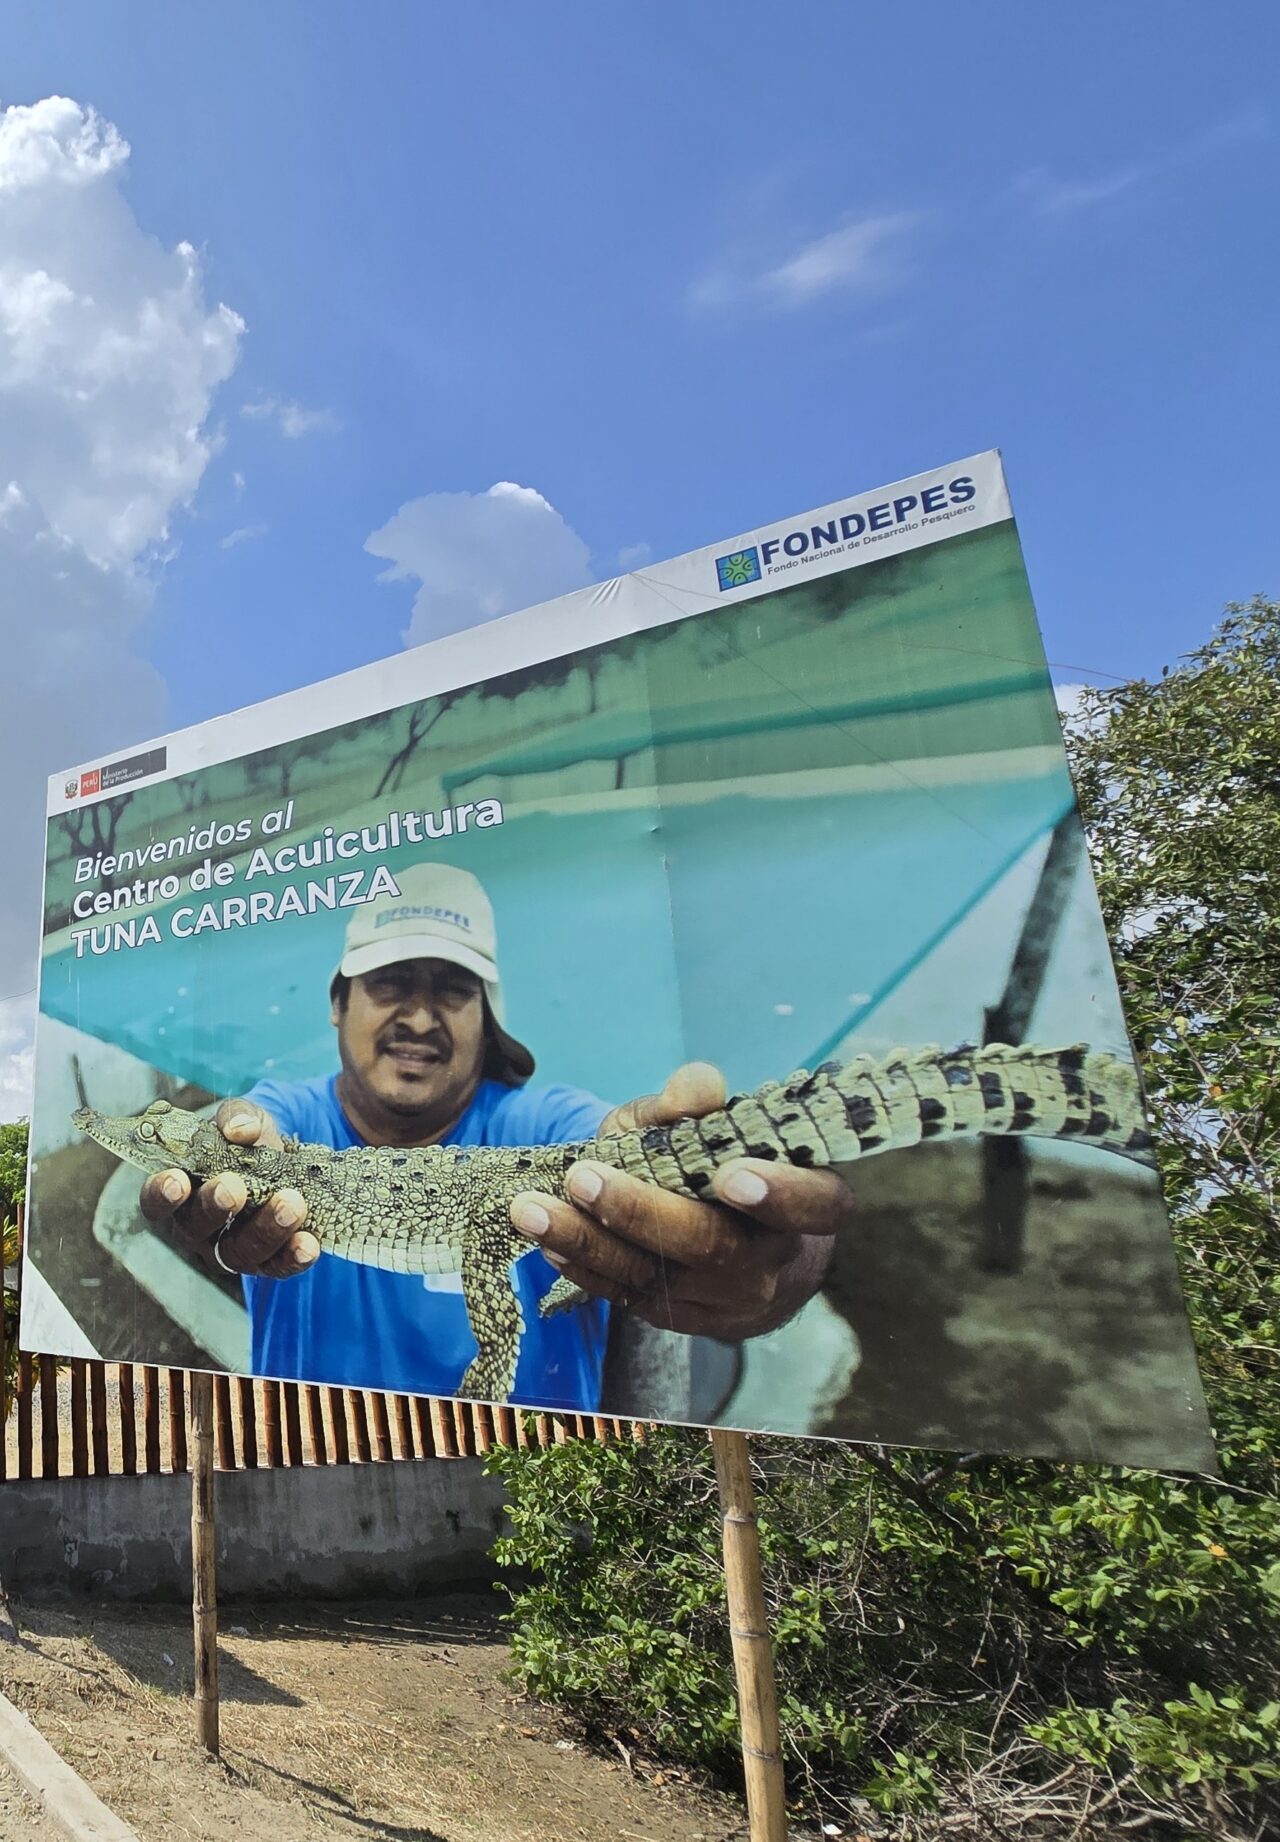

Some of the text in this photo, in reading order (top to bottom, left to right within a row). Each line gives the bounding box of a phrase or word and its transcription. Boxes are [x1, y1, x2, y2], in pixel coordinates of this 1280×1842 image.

[761, 476, 977, 565] FONDEPES
[767, 503, 976, 575] Fondo Nacional de Desarrollo Pesquero
[72, 797, 505, 919] Centro de Acuicultura
[74, 800, 295, 884] Bienvenidos al
[71, 865, 402, 959] TUNA CARRANZA
